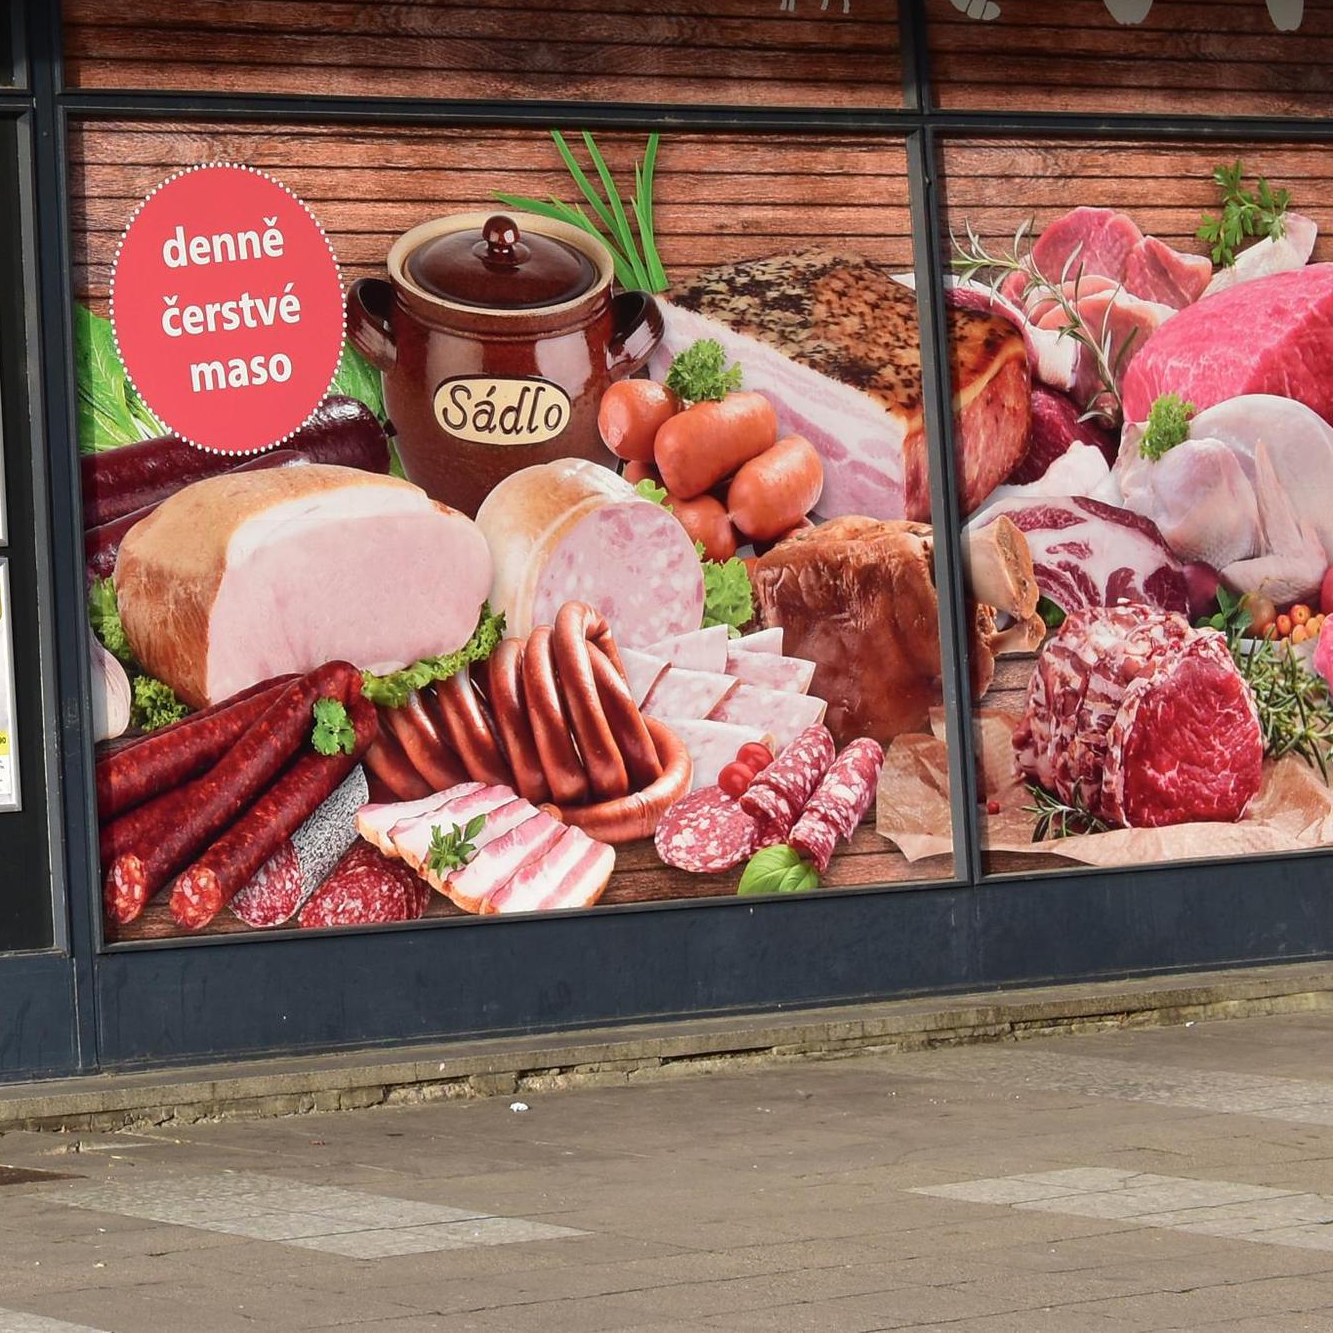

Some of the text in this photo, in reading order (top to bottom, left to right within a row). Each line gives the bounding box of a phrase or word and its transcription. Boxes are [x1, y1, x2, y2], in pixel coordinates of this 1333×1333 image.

[162, 216, 285, 269] denně
[161, 282, 301, 338] čerstvé
[189, 351, 293, 393] maso
[442, 383, 564, 437] Sádlo
